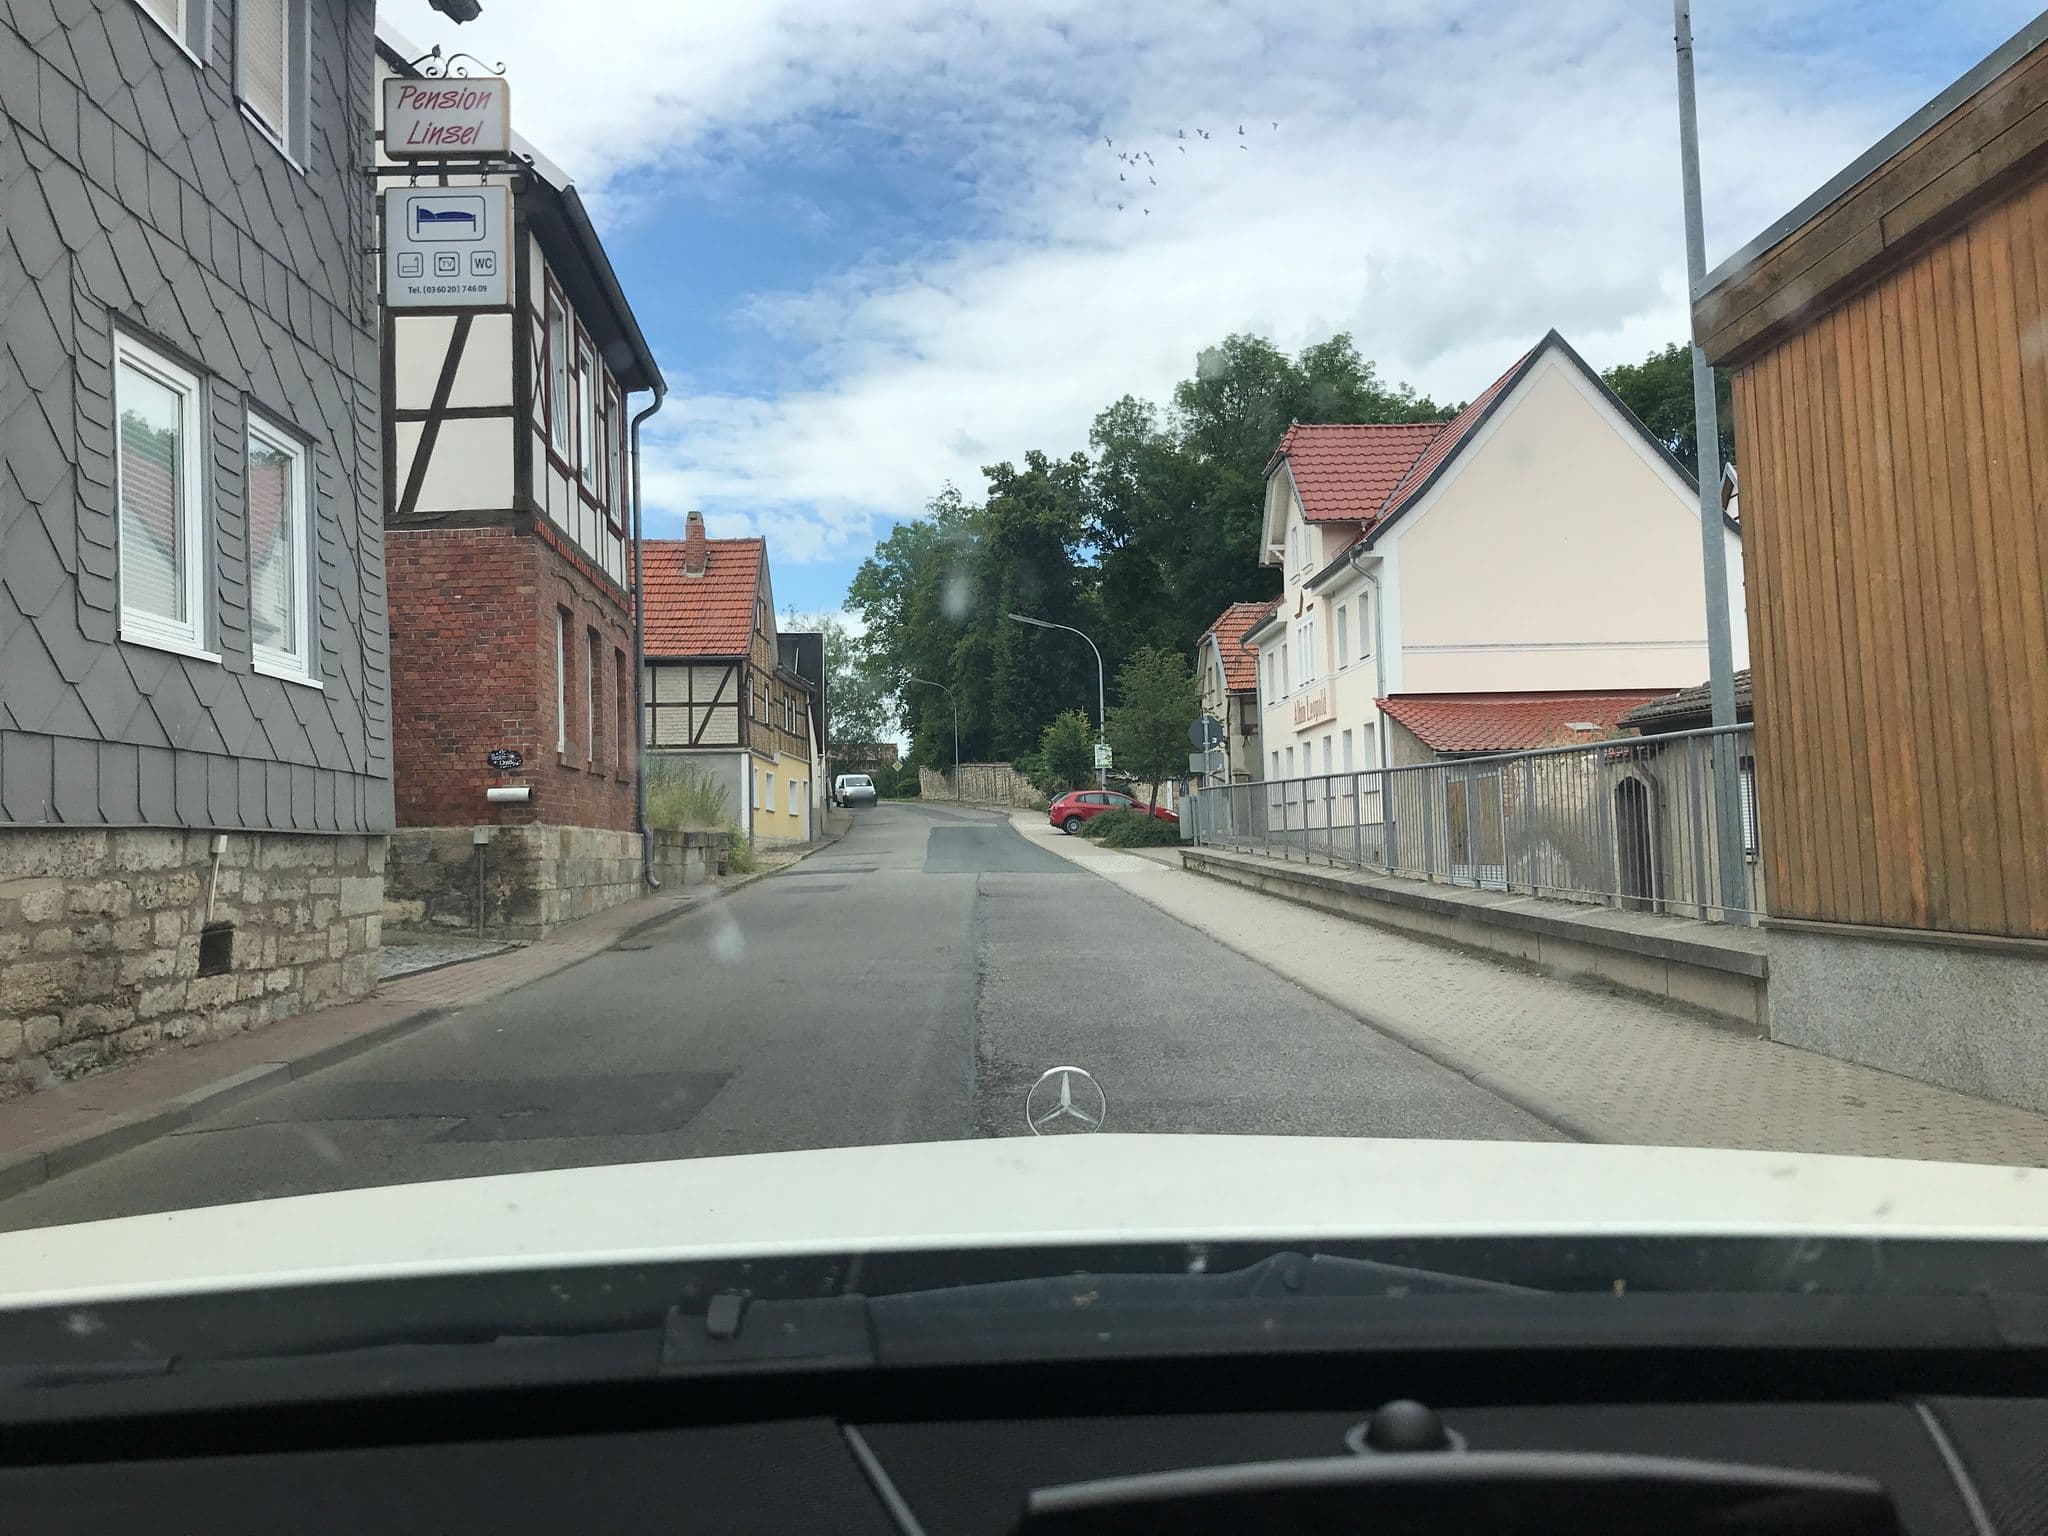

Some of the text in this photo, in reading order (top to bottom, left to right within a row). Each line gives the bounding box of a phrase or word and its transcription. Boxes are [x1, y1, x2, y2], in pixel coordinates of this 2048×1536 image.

[397, 85, 492, 110] Pension
[406, 120, 484, 145] Linsel
[475, 257, 493, 269] WC
[407, 286, 422, 294] Tel.
